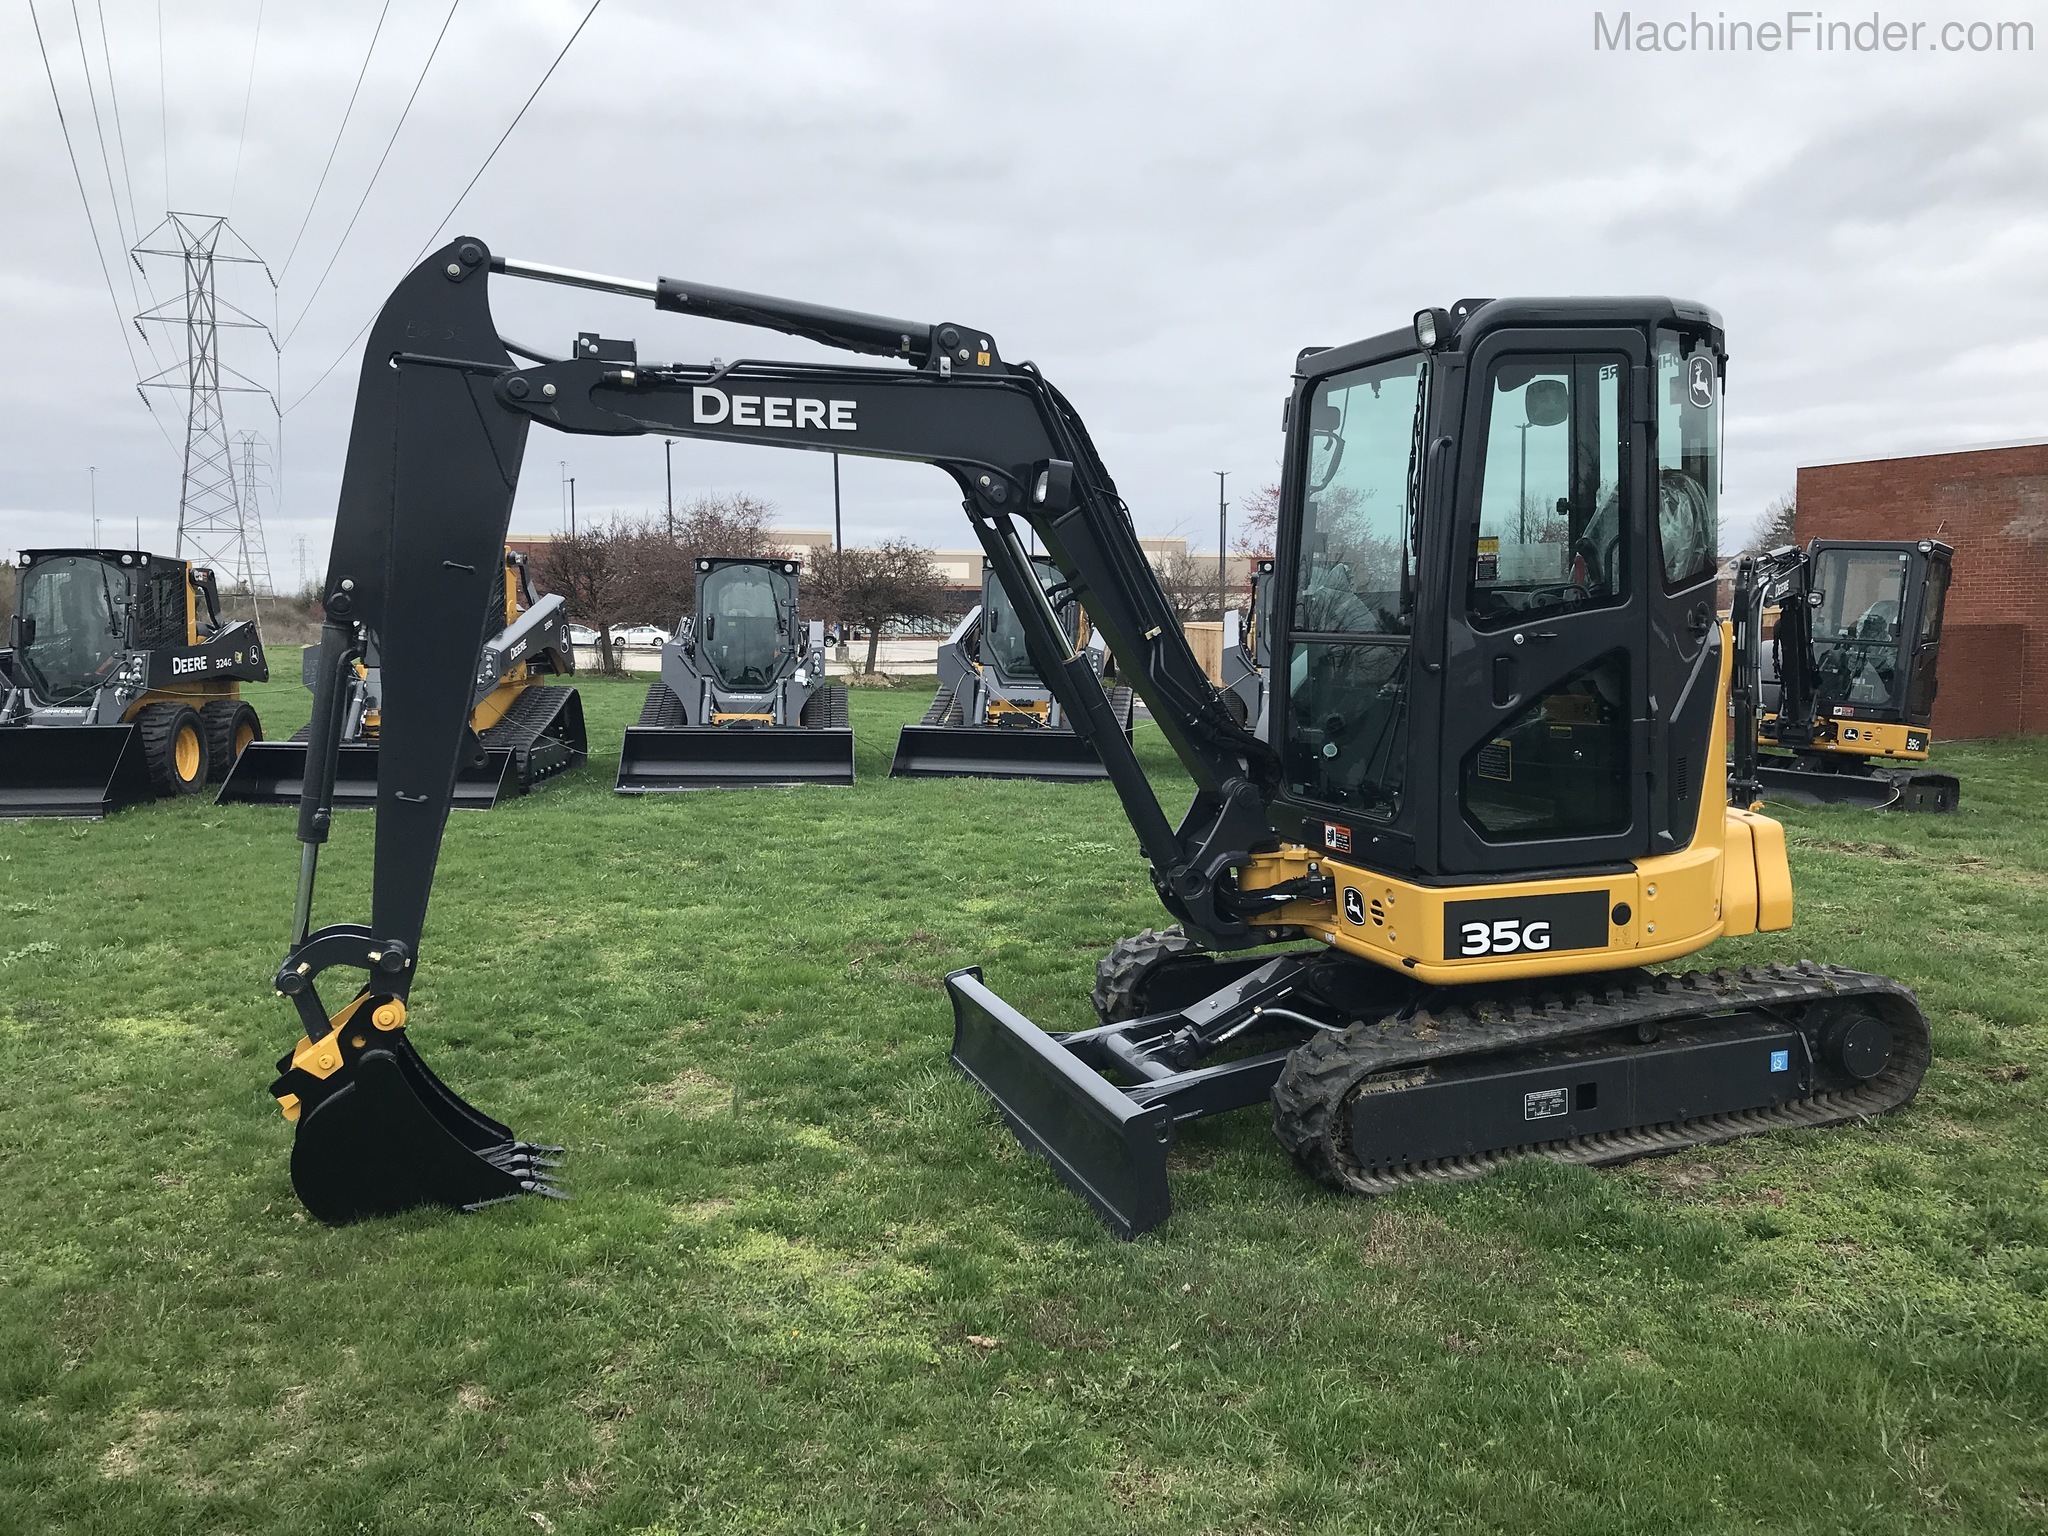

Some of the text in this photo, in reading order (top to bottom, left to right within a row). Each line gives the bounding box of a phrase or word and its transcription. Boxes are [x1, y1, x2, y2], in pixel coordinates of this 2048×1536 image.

[693, 386, 857, 431] DEERE
[1775, 579, 1790, 598] DEERE
[510, 638, 528, 661] DEERE
[172, 655, 232, 675] DEERE 324G
[1462, 920, 1550, 955] 35G
